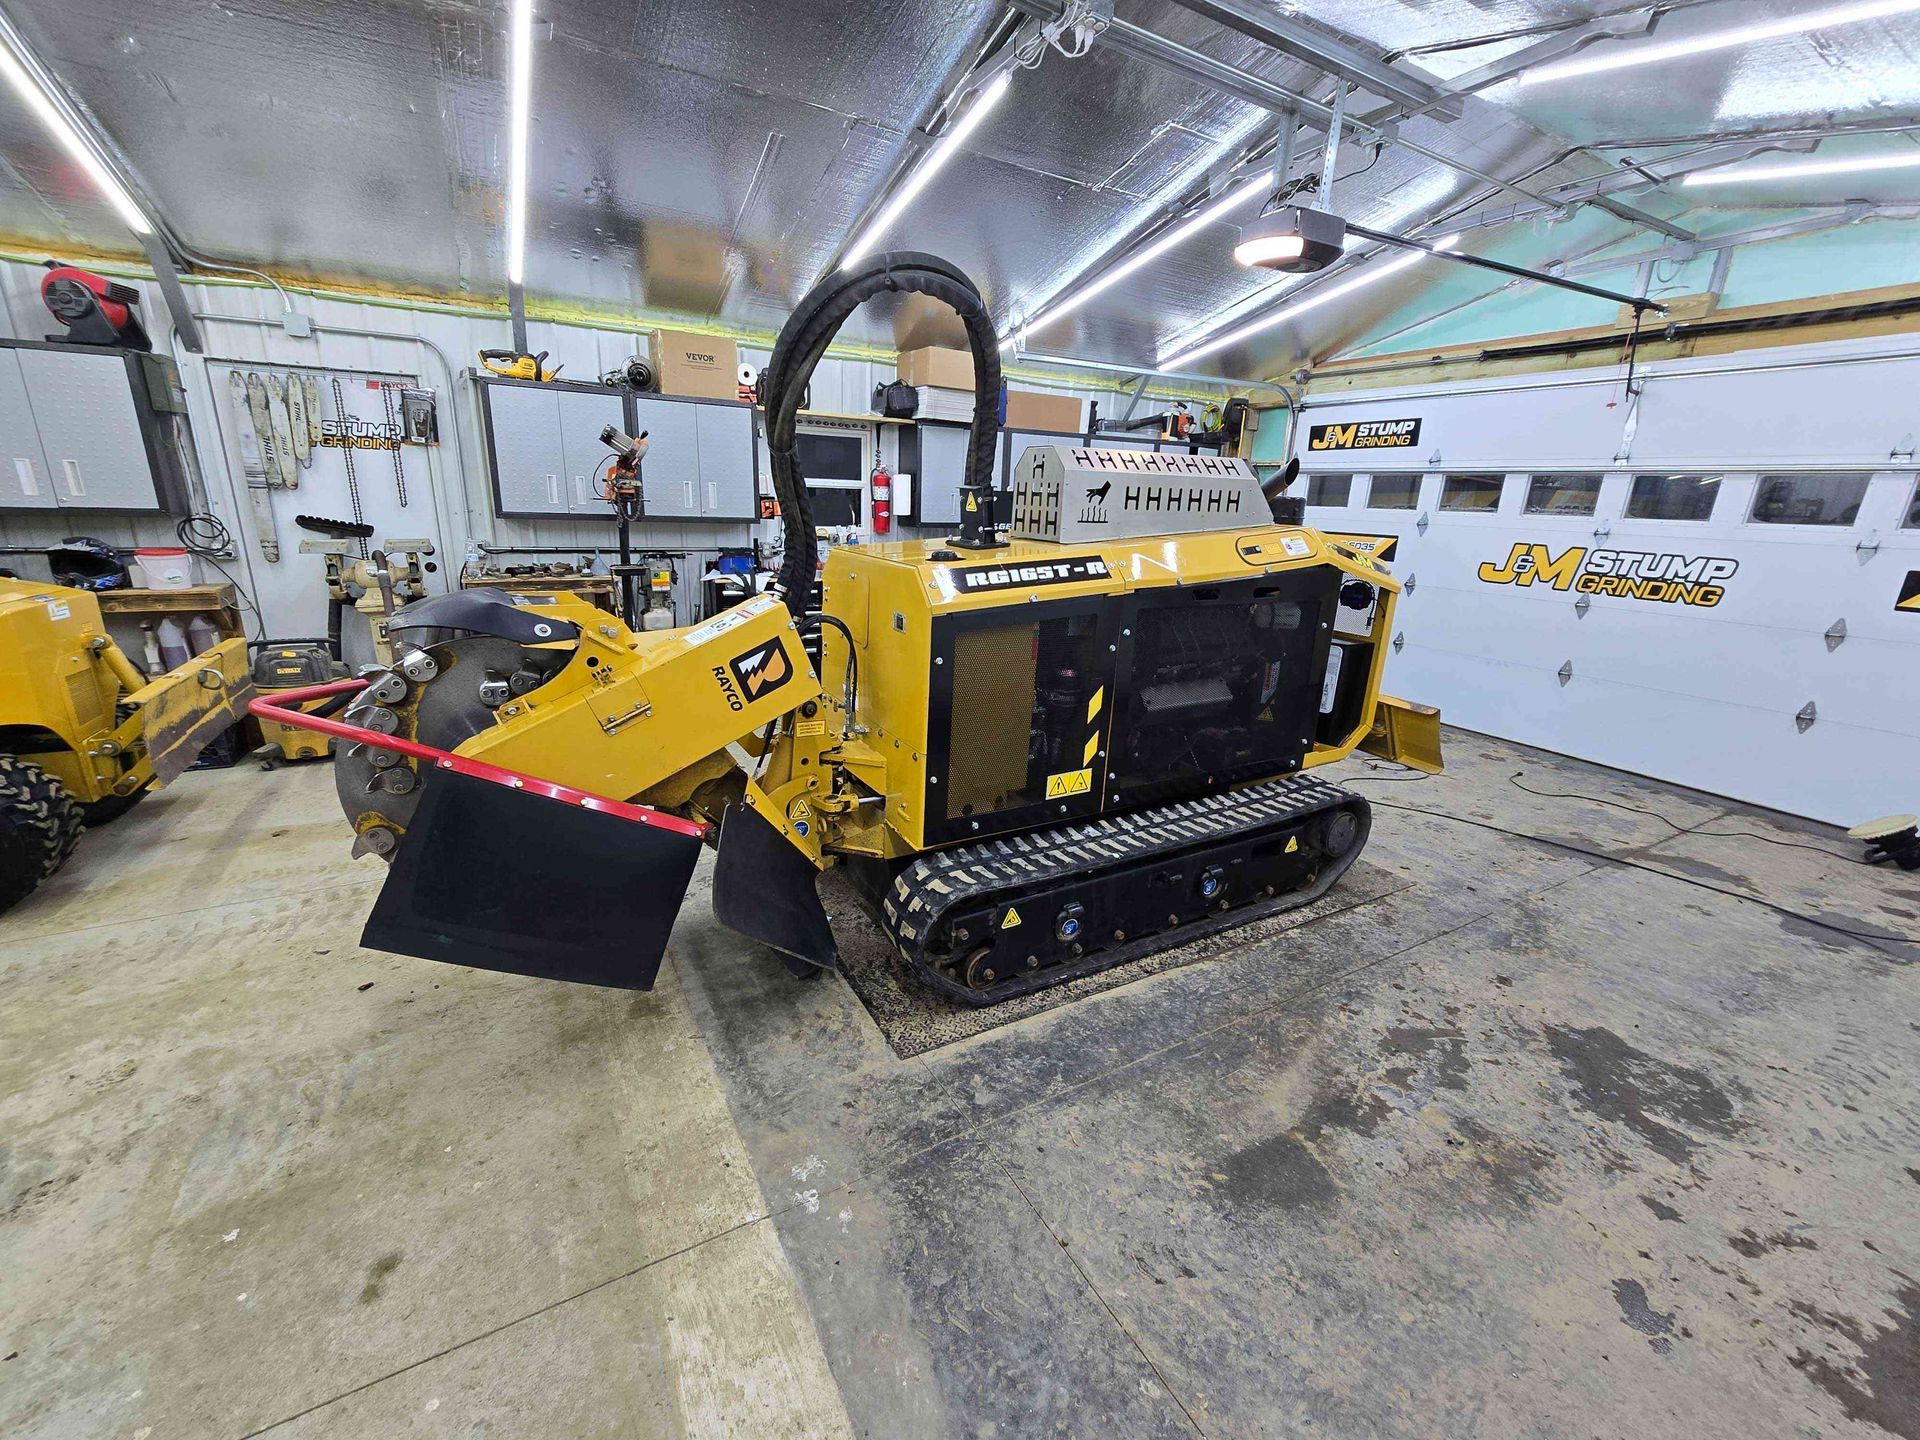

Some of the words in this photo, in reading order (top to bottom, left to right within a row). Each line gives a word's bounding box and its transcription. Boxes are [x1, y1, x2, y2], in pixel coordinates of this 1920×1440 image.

[685, 352, 714, 362] VEVOR
[294, 401, 302, 423] STIHL
[1312, 424, 1357, 449] J&M
[1354, 435, 1411, 448] GRINDING
[1358, 421, 1416, 436] STUMP
[263, 435, 275, 465] STIHL
[1478, 543, 1589, 592] J&M
[1585, 549, 1739, 583] STUMP
[1575, 573, 1725, 607] GRINDING
[711, 665, 743, 712] RAYCO
